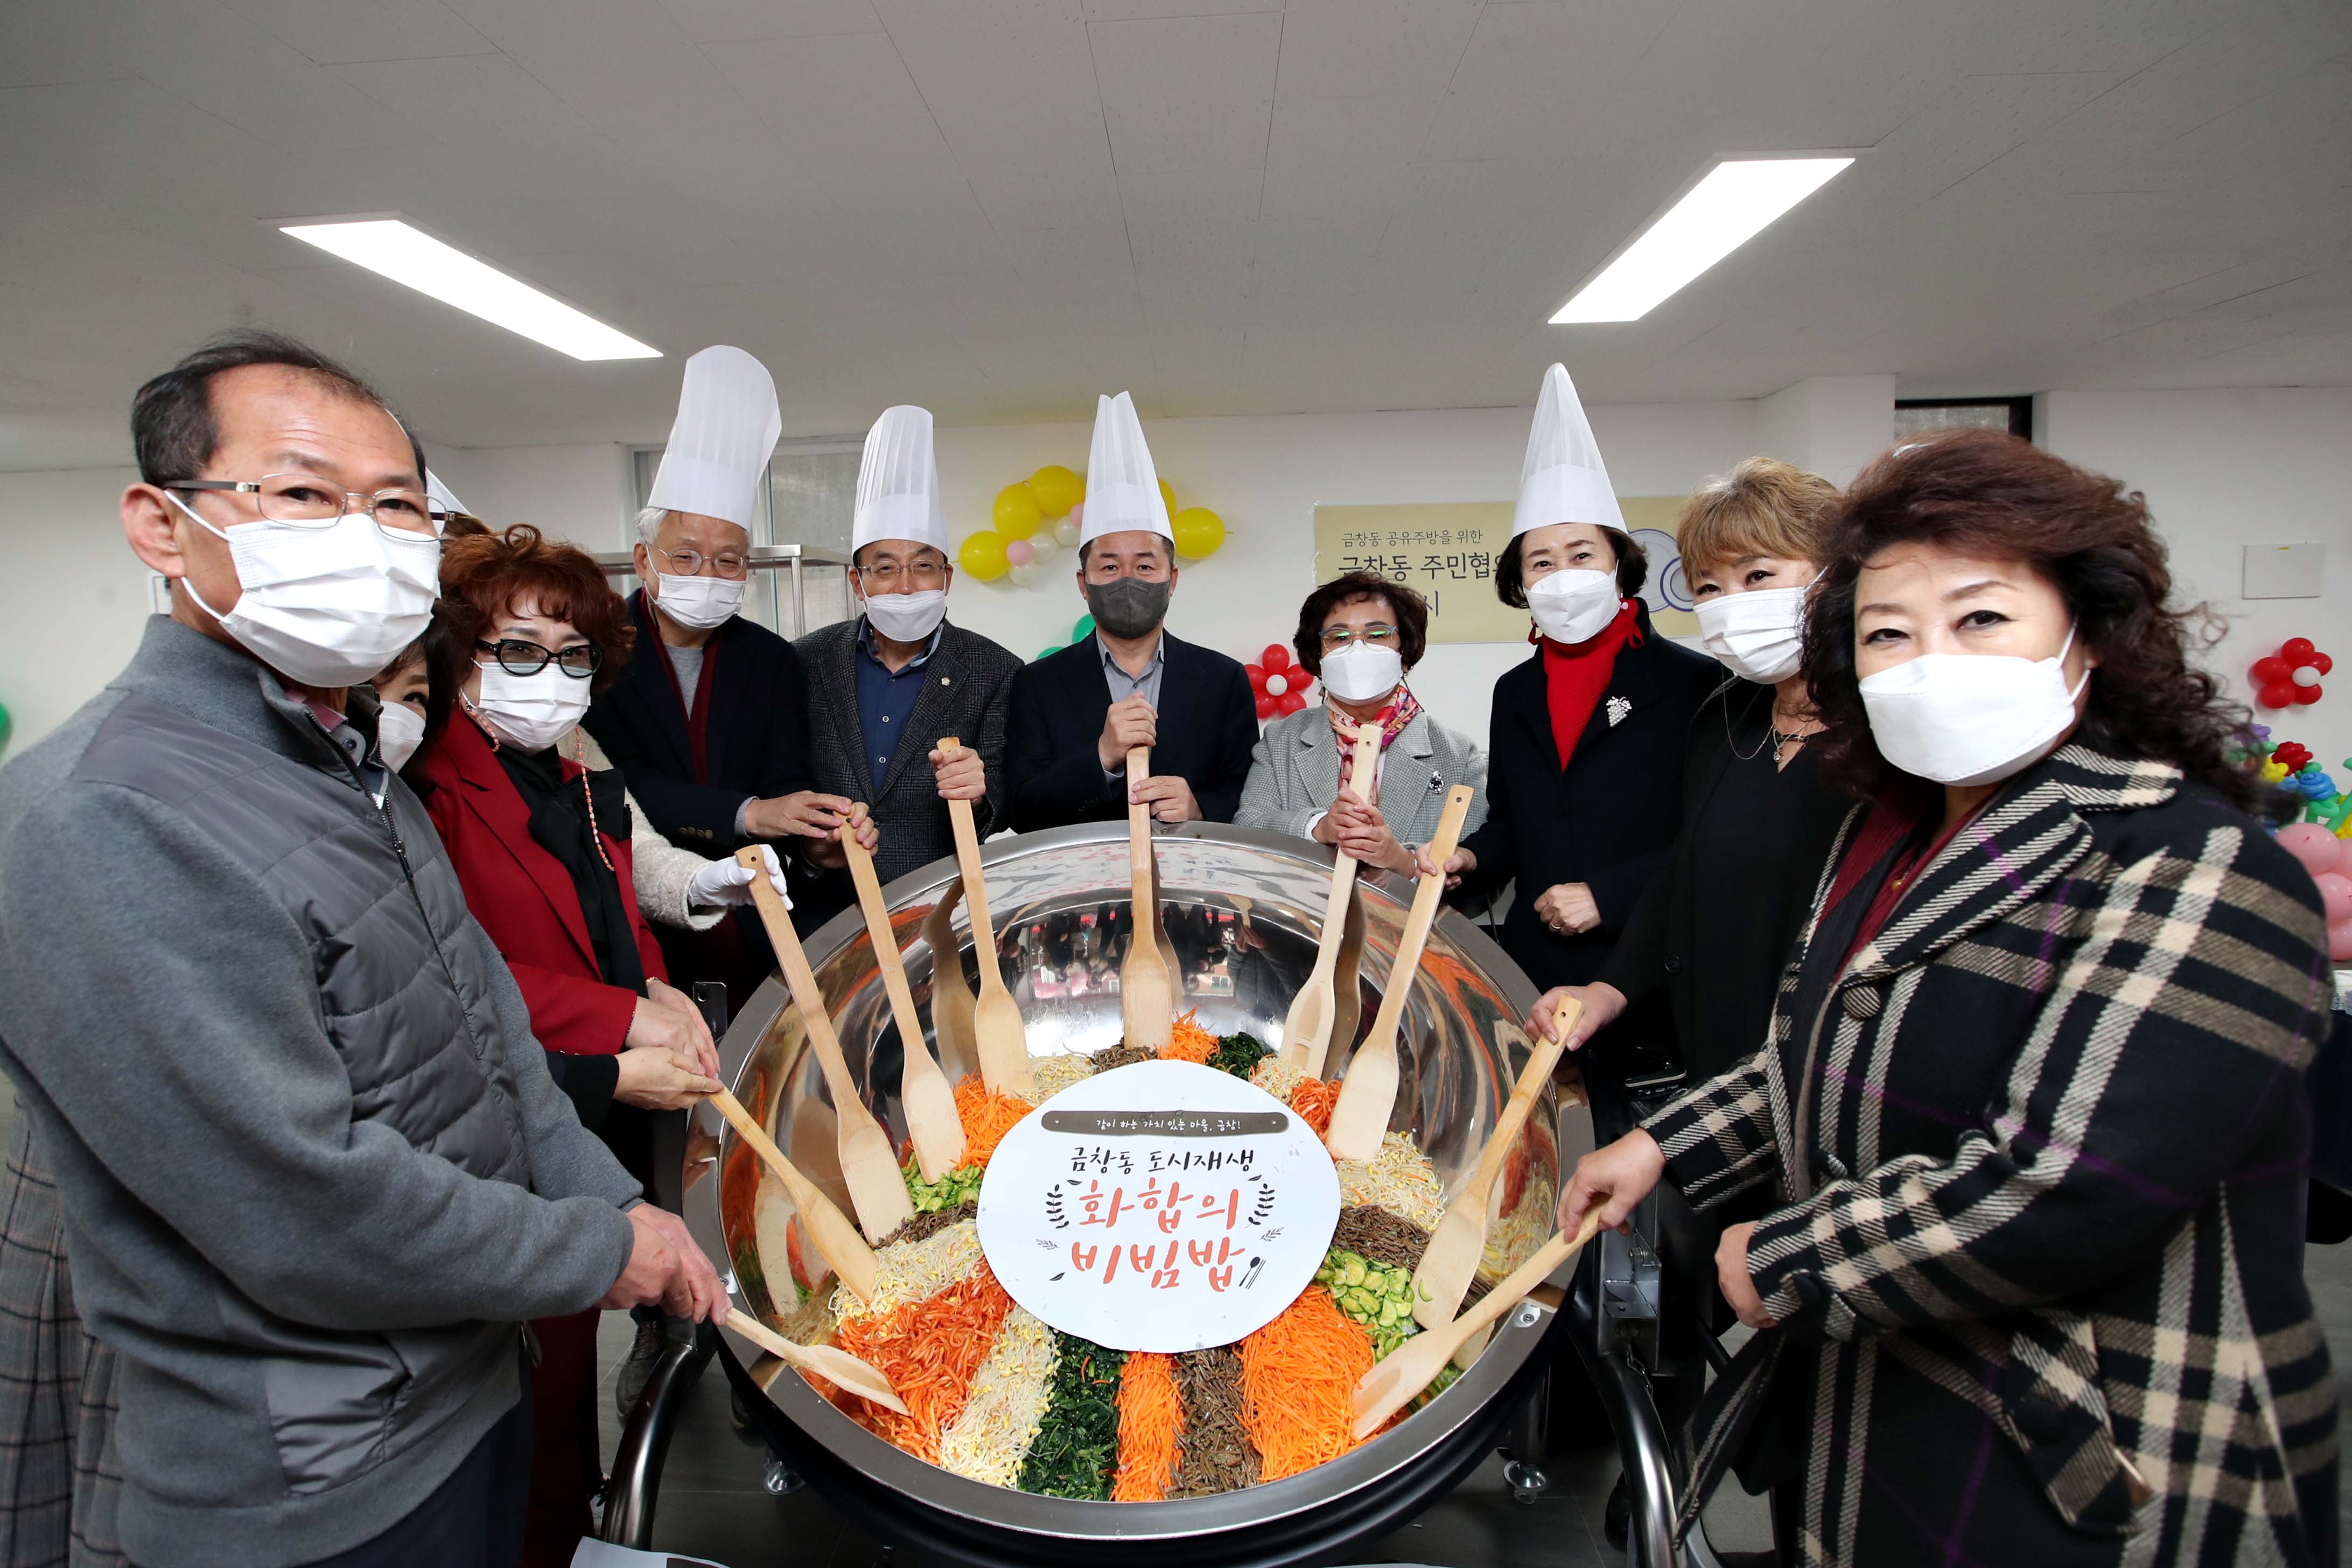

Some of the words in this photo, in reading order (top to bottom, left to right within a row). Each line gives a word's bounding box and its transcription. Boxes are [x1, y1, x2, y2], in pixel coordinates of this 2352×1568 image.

[1341, 531, 1382, 548] 금창동
[1385, 529, 1453, 547] 공유주방을
[1456, 529, 1483, 544] 위한
[1096, 1118, 1116, 1131] 같이
[1119, 1119, 1138, 1130] 하는
[1143, 1119, 1165, 1129] 가치
[1167, 1118, 1186, 1131] 있는
[1189, 1118, 1213, 1132] 마을,
[1216, 1119, 1241, 1132] 금창!
[1070, 1146, 1135, 1175] 금창동
[1148, 1149, 1254, 1173] 도시재생
[1079, 1177, 1240, 1234] 화합의
[1071, 1236, 1245, 1293] 비빔밥
